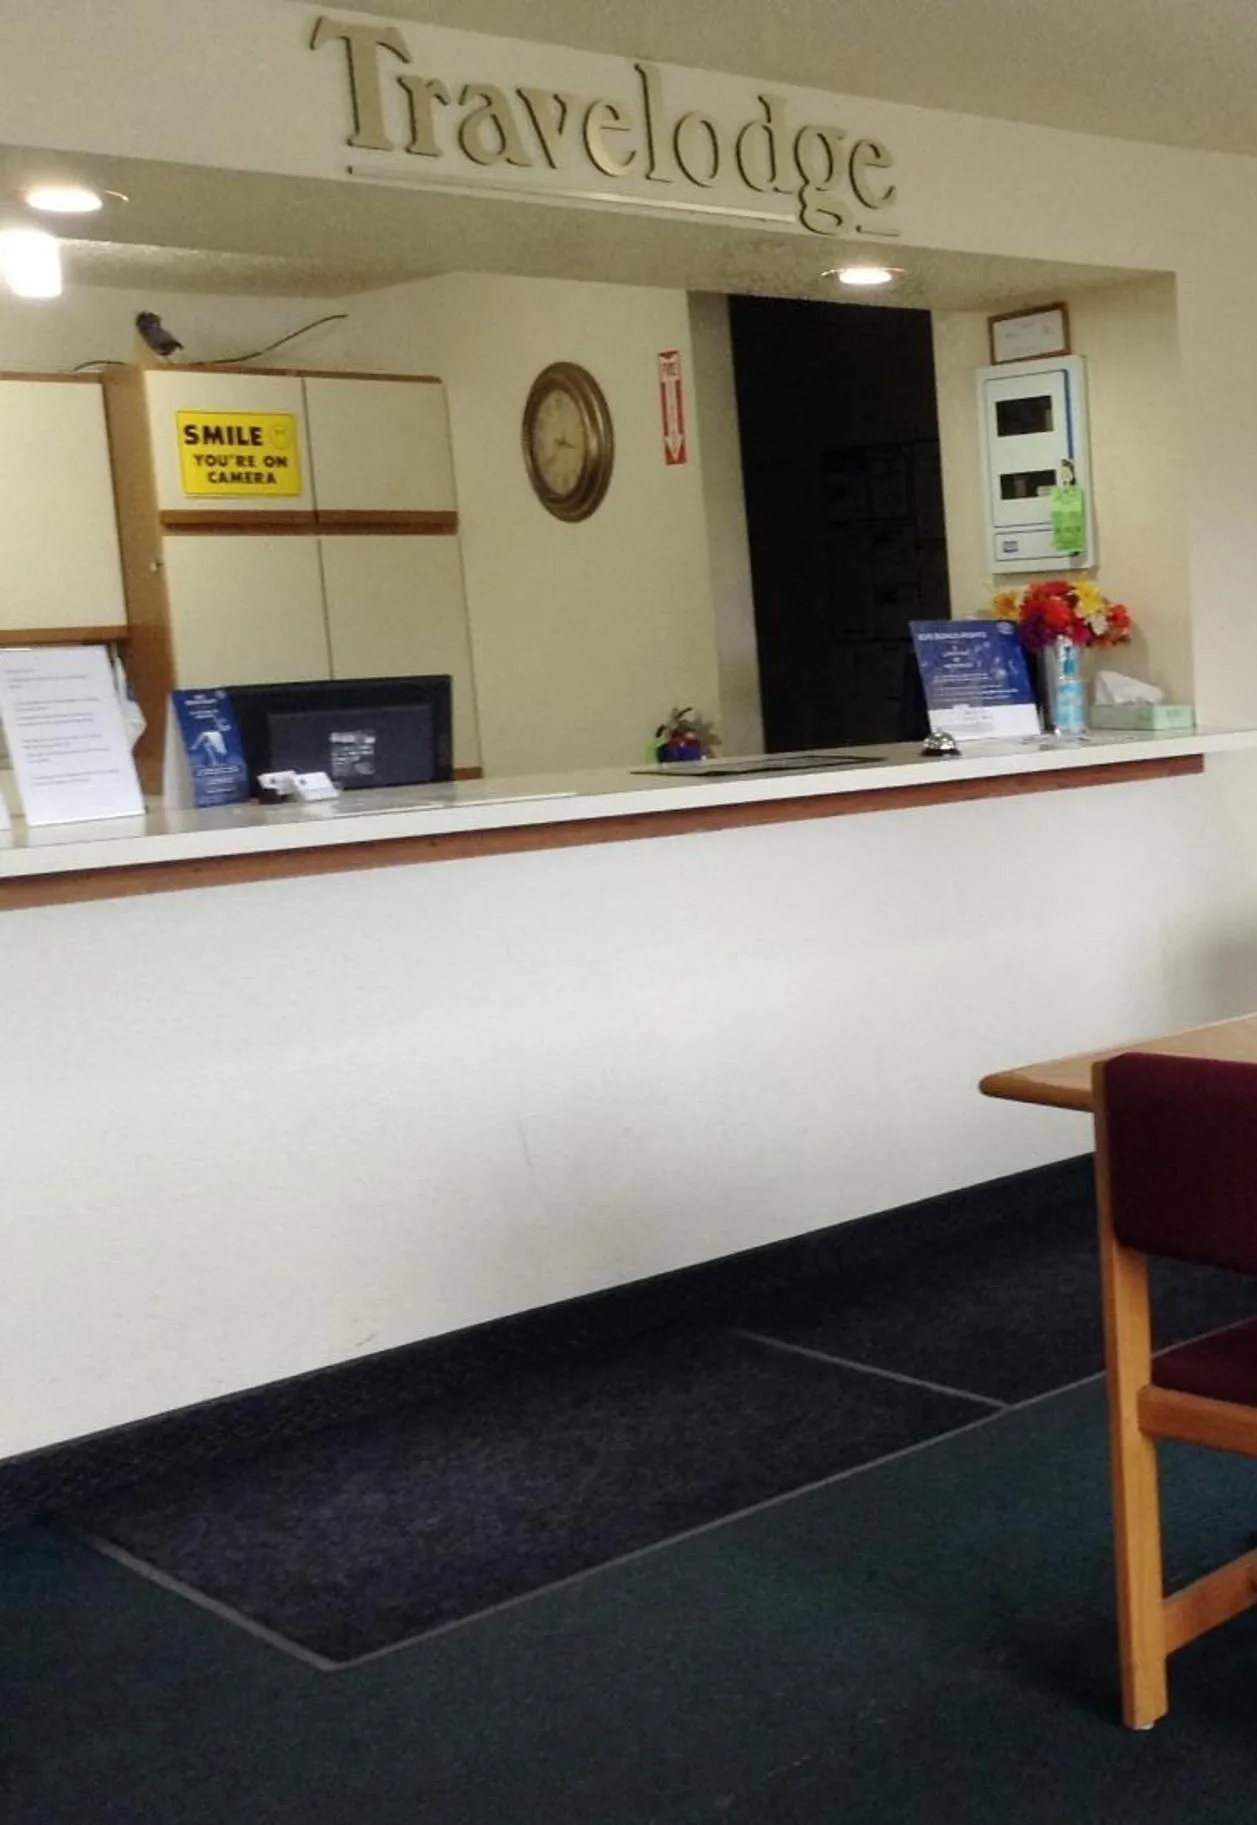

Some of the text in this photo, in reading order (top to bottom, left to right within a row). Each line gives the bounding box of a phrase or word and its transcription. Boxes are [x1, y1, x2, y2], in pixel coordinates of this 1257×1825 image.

[310, 15, 897, 235] Travelodge
[183, 424, 263, 446] SMILE
[193, 454, 288, 468] YOU'RE ON
[207, 471, 278, 485] CAMERA
